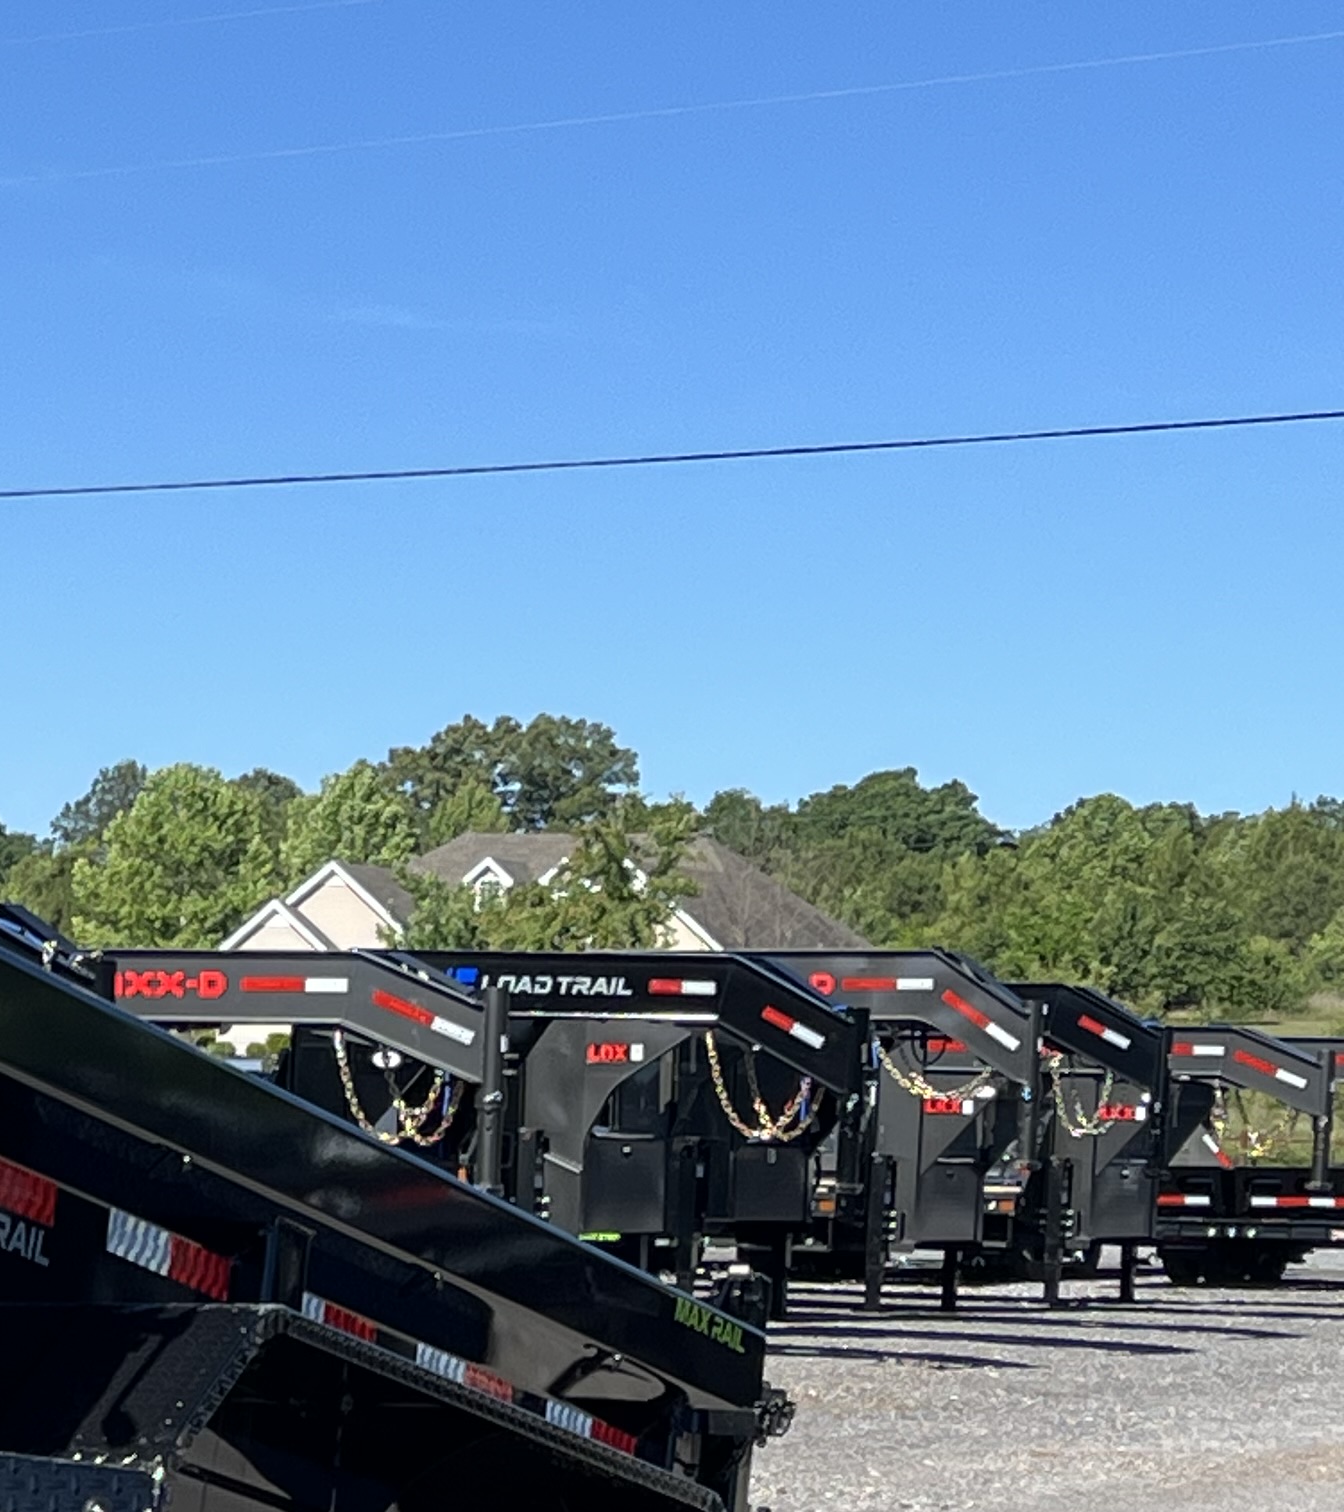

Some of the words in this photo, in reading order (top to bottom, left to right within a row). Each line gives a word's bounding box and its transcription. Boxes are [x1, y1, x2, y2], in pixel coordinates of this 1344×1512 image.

[556, 976, 634, 996] TRAIL
[585, 1043, 628, 1064] LDX
[673, 1296, 713, 1337] MAX
[710, 1315, 746, 1354] RAIL
